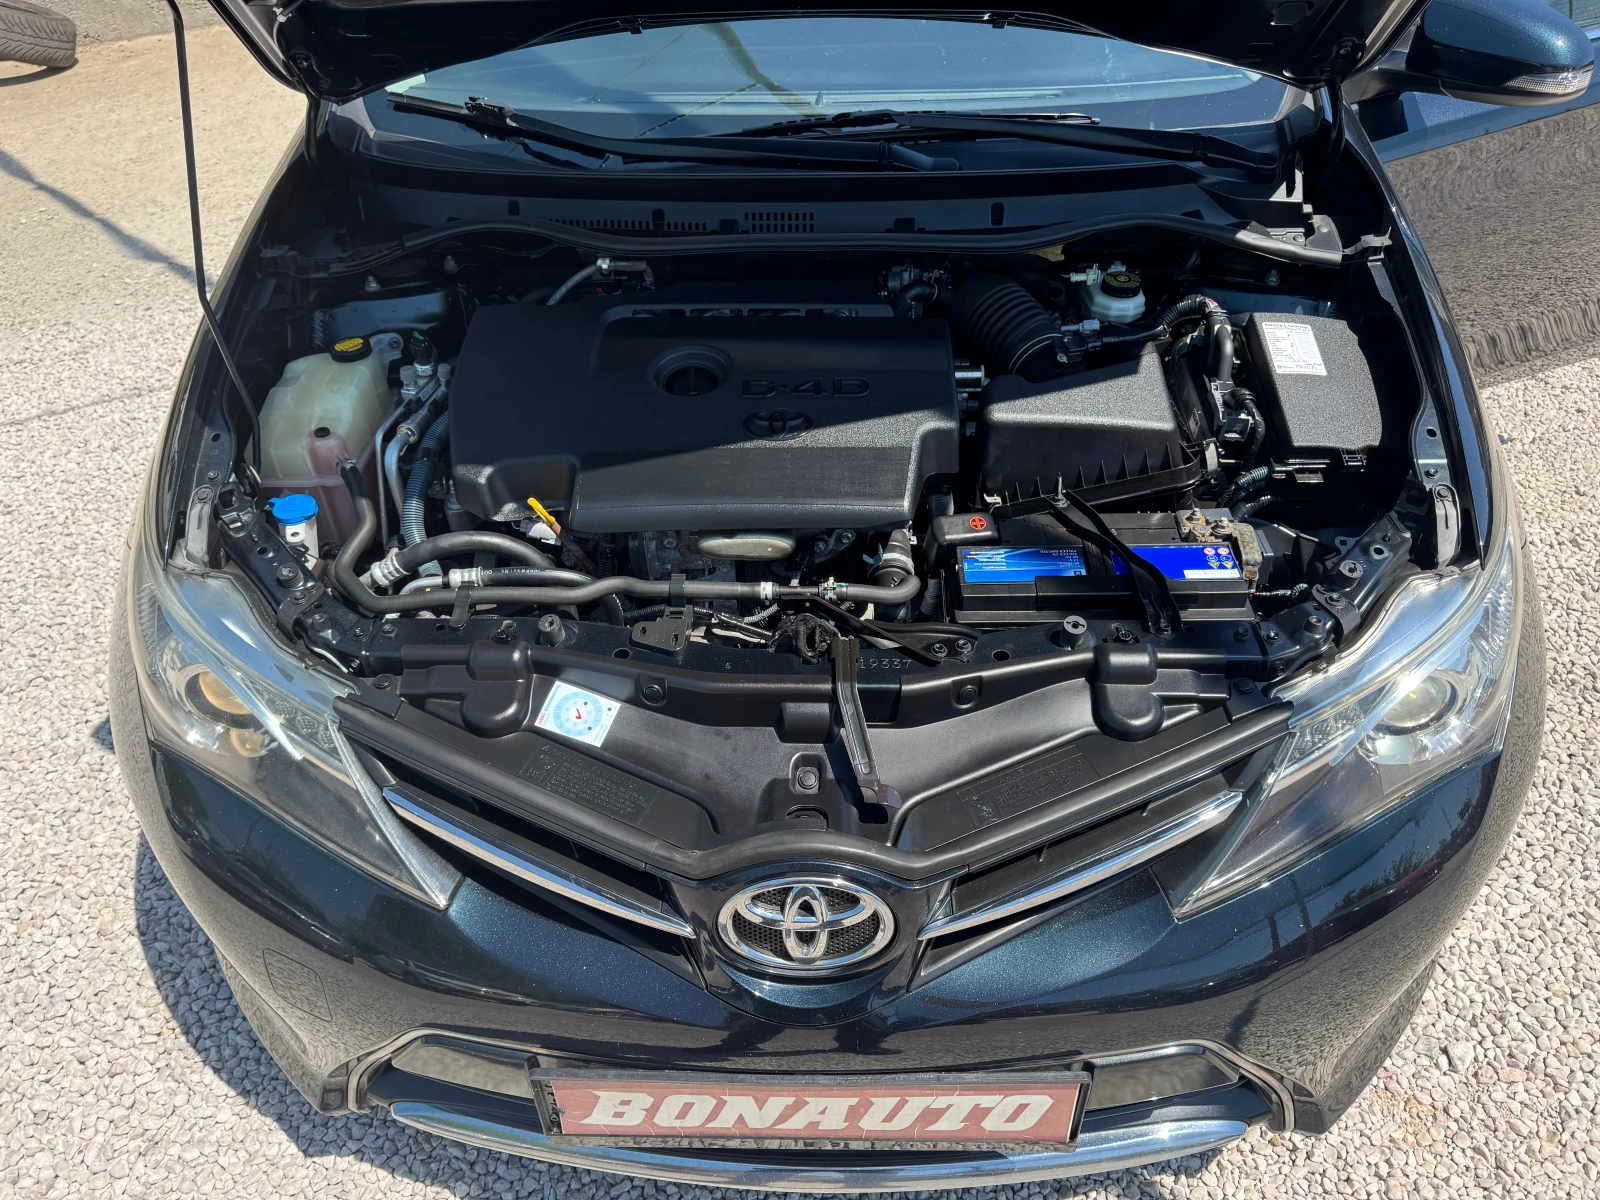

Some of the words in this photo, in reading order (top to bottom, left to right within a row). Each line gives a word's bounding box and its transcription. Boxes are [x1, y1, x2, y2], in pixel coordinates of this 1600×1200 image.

[742, 378, 870, 398] D-4D
[860, 658, 912, 669] 19337
[580, 1090, 1054, 1131] BONAUTO
